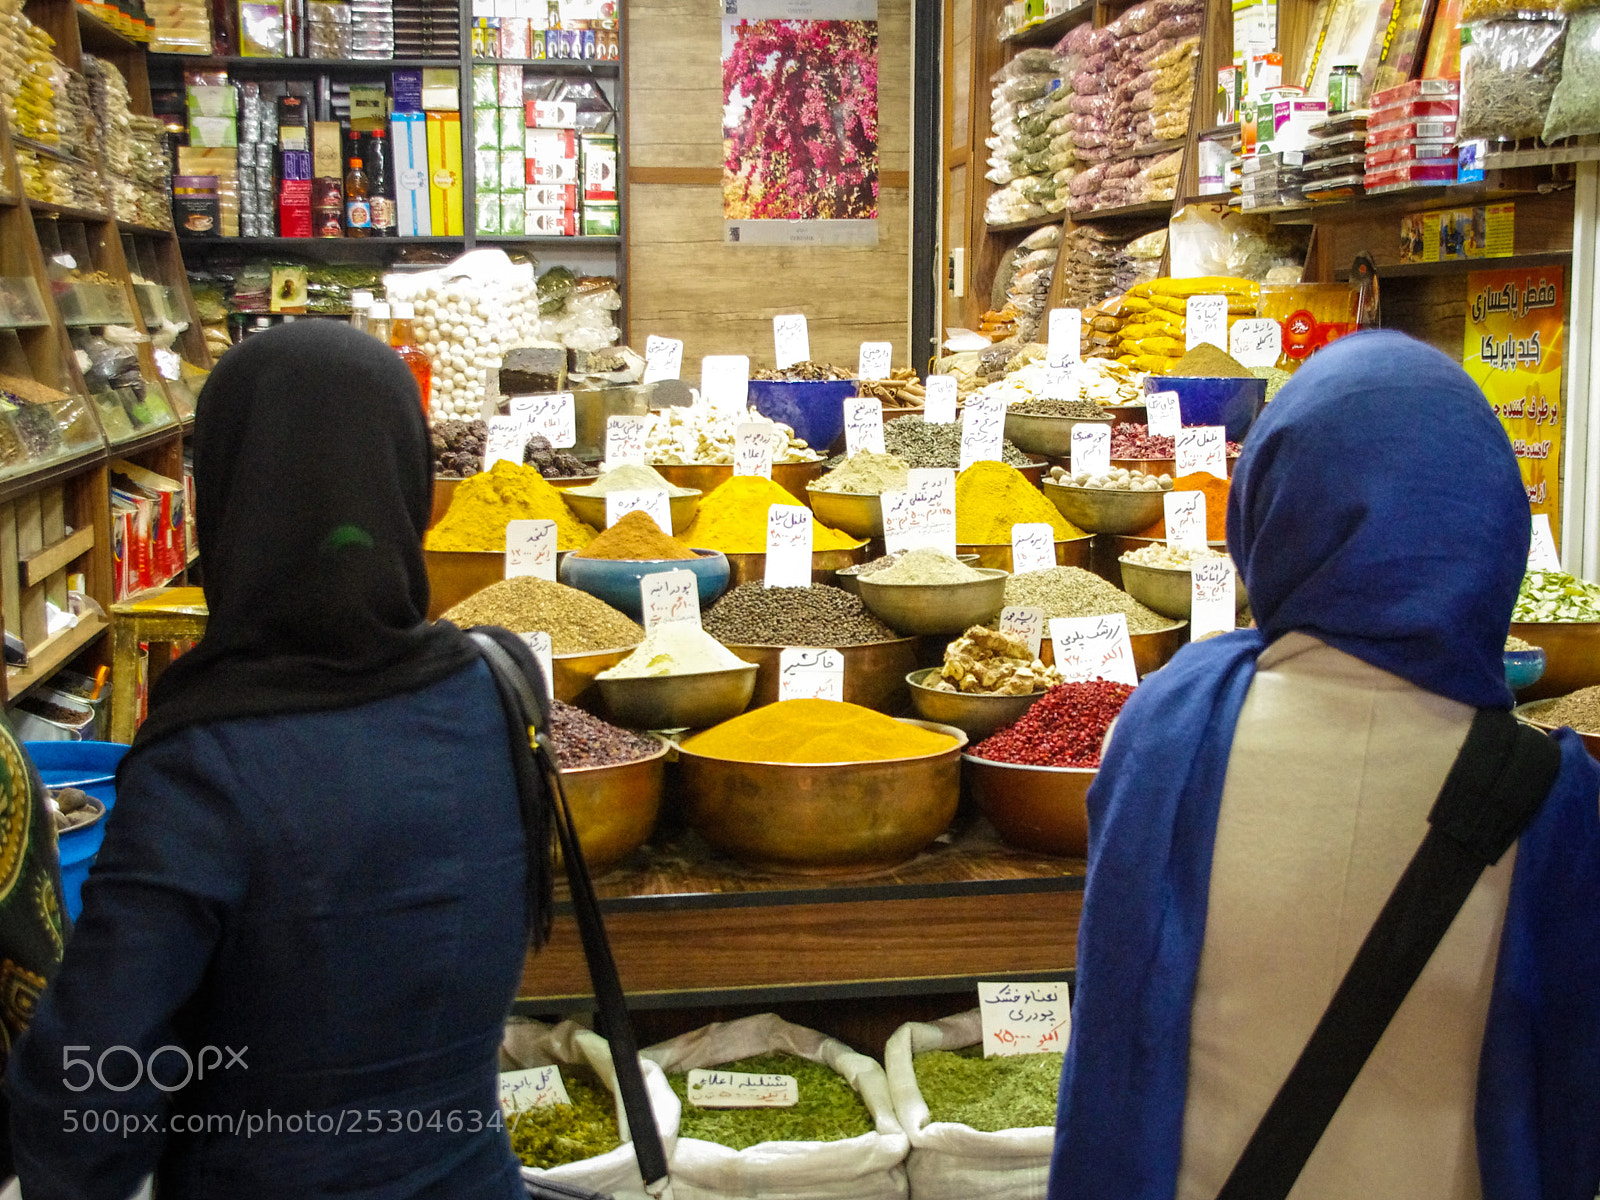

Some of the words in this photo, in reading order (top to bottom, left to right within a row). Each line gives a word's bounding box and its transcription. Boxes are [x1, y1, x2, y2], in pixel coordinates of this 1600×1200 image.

[1472, 282, 1518, 322] پاکسازی
[1521, 278, 1555, 318] مقطر
[1481, 333, 1516, 371] پاپریکا
[1517, 331, 1540, 367] کبد
[783, 512, 806, 529] فلفل
[526, 523, 555, 547] کنجد
[1086, 618, 1121, 640] زرشک
[783, 649, 835, 676] خاکشیر
[985, 984, 1021, 1004] خشک
[1009, 1009, 1056, 1027] پودری
